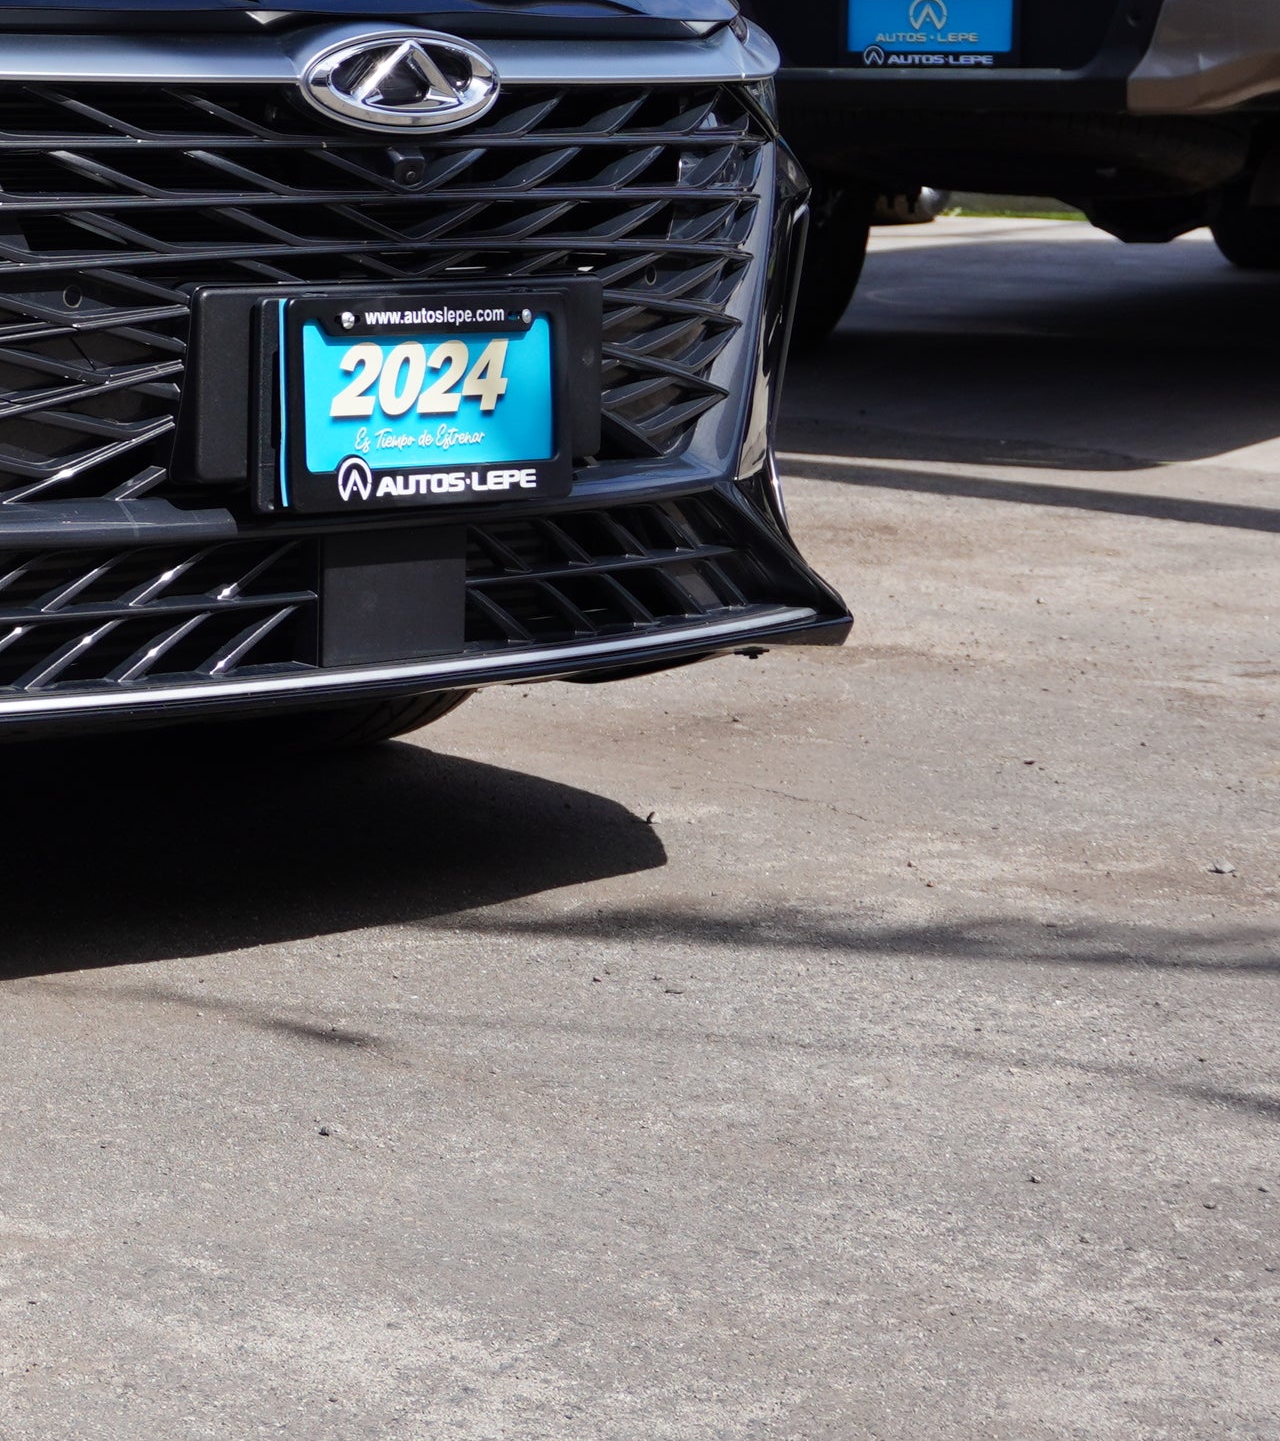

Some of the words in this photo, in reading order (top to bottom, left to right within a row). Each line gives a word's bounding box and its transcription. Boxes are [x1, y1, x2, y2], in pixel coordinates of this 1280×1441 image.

[365, 307, 505, 326] www.autoslepe.com
[330, 338, 510, 418] 2024
[354, 426, 371, 454] Es
[375, 428, 416, 451] Tiempo
[418, 424, 434, 447] de
[435, 423, 486, 448] Estrenar
